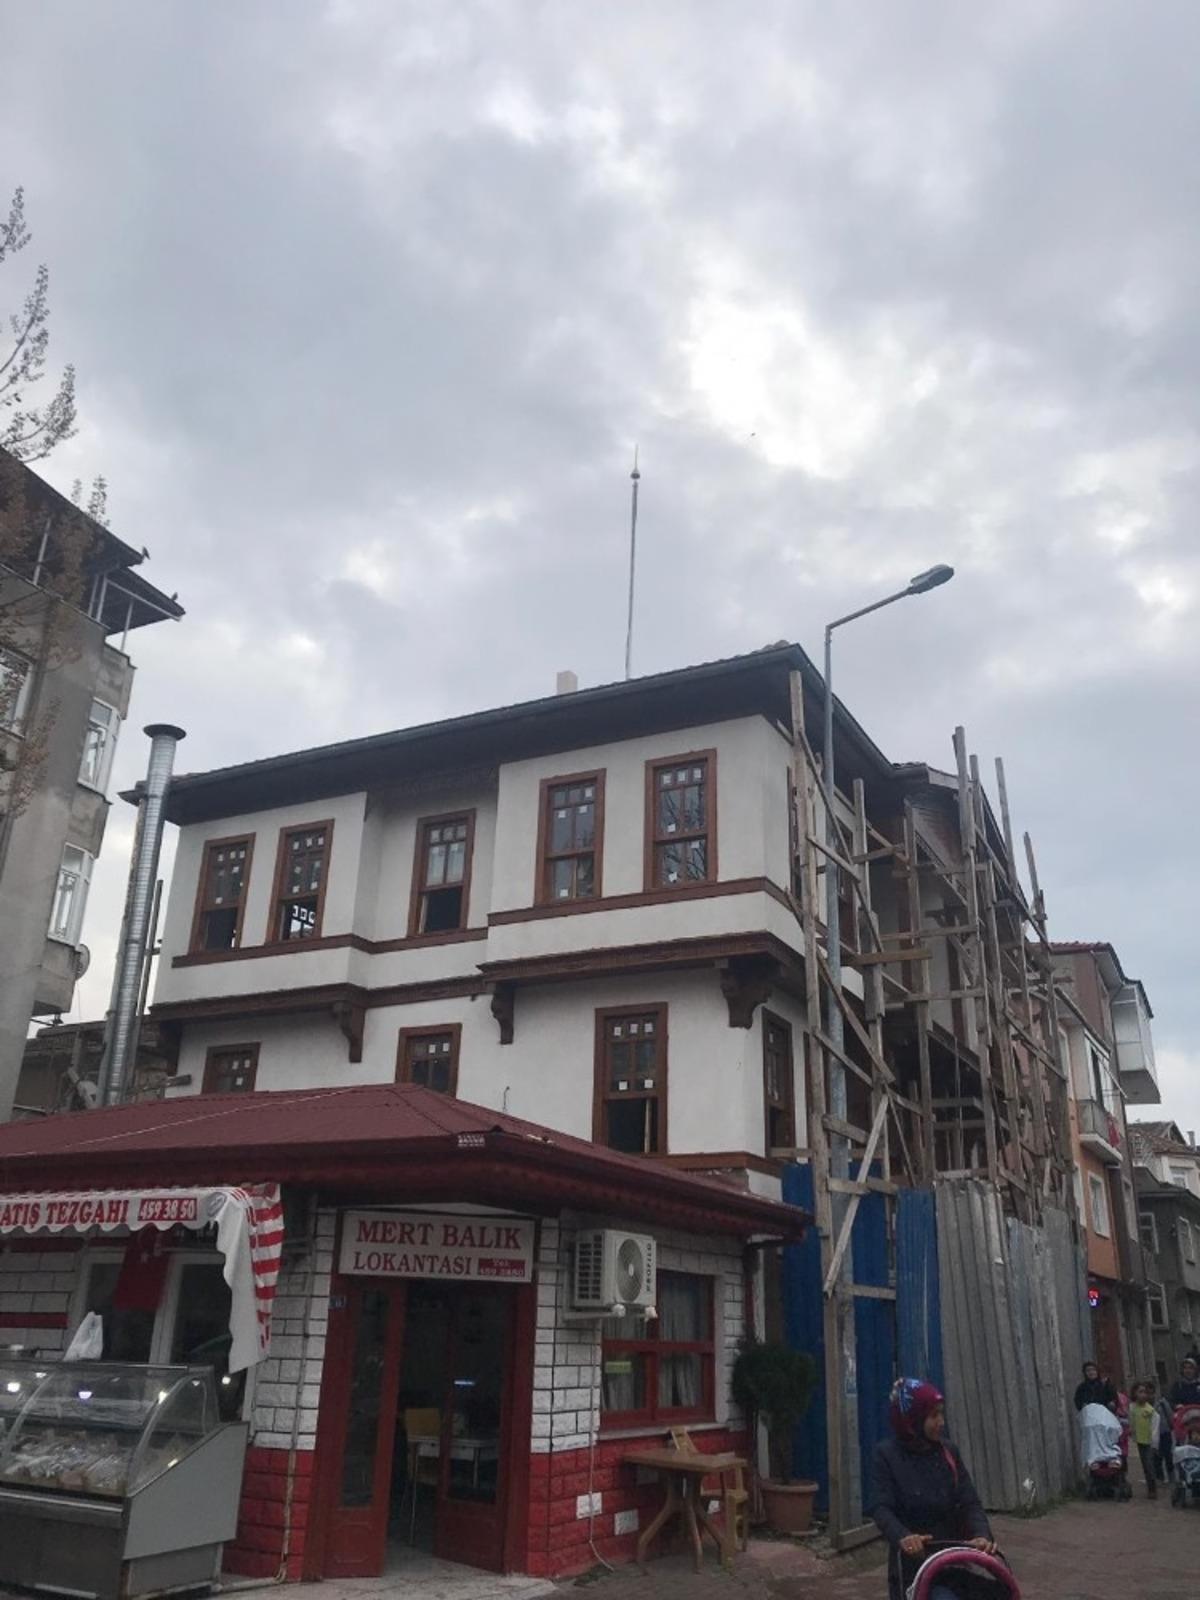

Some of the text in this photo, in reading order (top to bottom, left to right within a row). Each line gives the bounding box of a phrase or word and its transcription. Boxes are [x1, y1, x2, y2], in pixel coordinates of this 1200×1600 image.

[46, 1199, 129, 1225] TEZGAHI
[140, 1199, 195, 1220] 459 38 50
[356, 1219, 522, 1250] MERT BALIK
[353, 1251, 472, 1275] LOKANTASI
